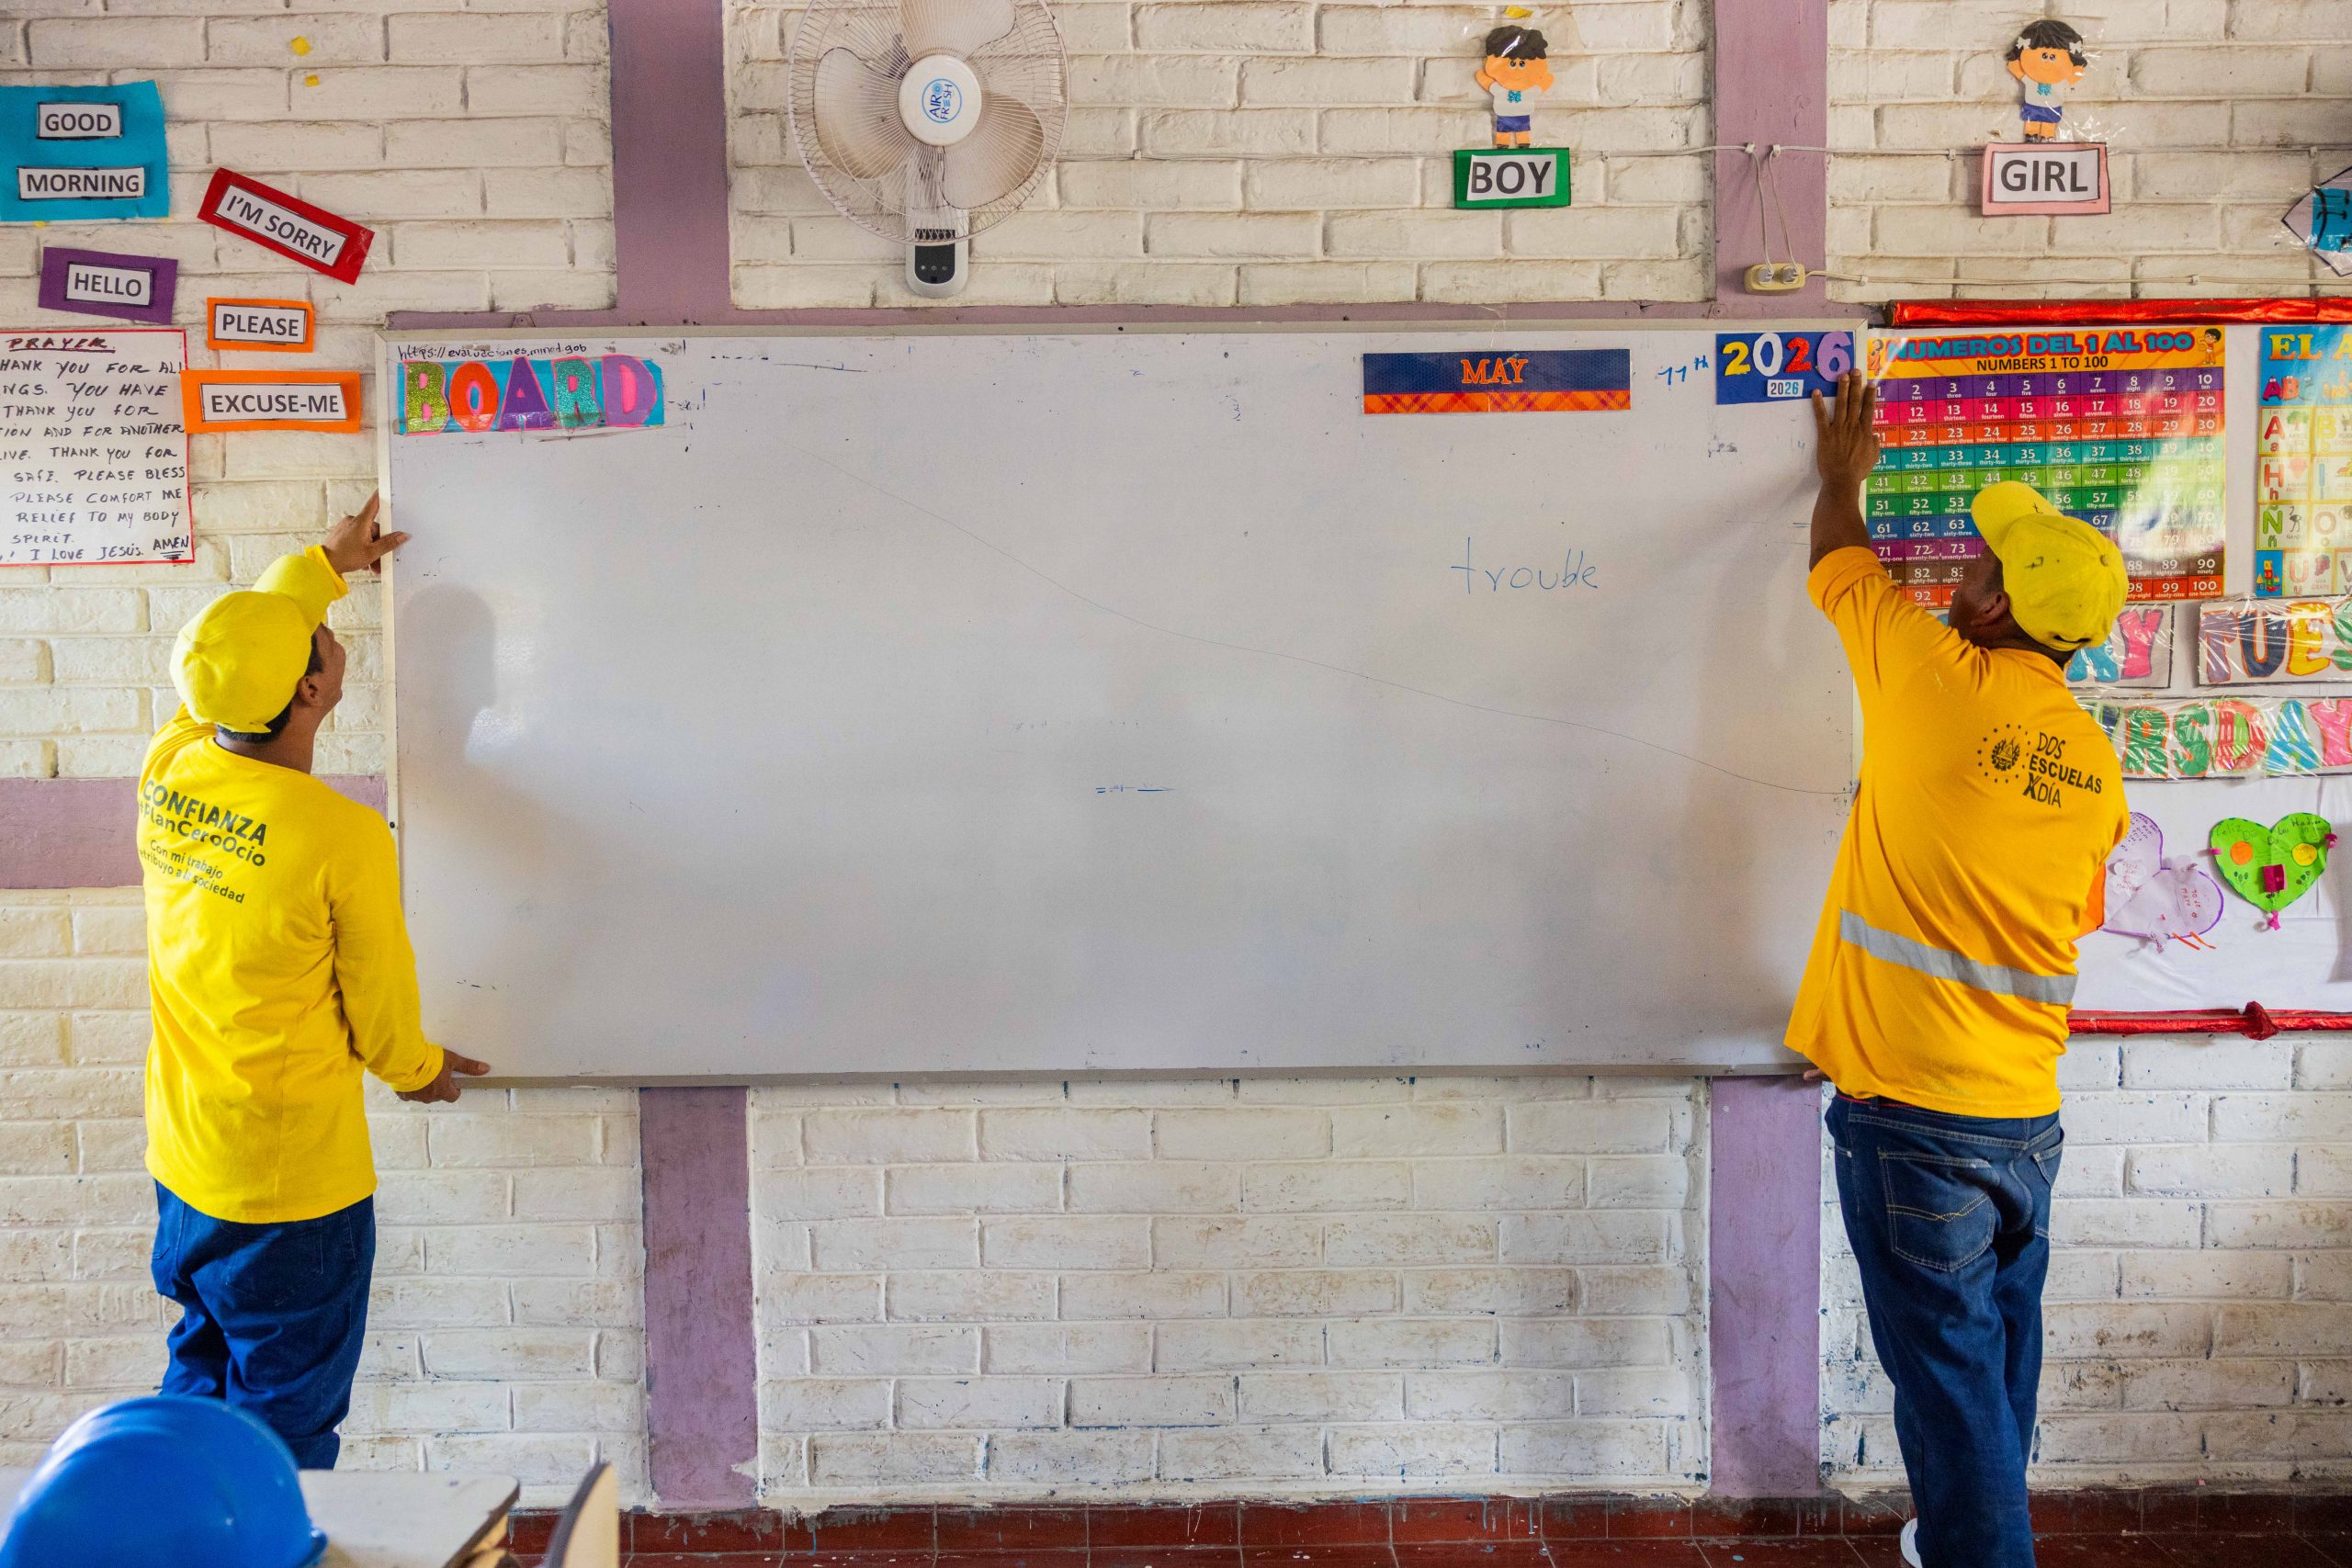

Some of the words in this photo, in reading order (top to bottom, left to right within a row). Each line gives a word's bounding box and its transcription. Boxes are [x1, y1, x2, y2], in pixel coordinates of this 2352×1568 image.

[929, 95, 943, 118] AIR
[940, 84, 954, 120] FRESH
[45, 113, 112, 131] GOOD
[1470, 161, 1553, 195] BOY
[2000, 159, 2088, 193] GIRL
[26, 174, 140, 192] MORNING
[227, 195, 263, 226] I'M
[265, 214, 335, 259] SORRY
[74, 272, 141, 298] HELLO
[222, 313, 300, 337] PLEASE
[1887, 336, 2022, 360] NUMEROS
[2028, 334, 2083, 355] DEL
[2086, 334, 2099, 354] 1
[2102, 333, 2142, 353] AL
[2145, 333, 2194, 352] 100
[2268, 333, 2323, 360] EL
[1722, 330, 1852, 382] 2026
[0, 358, 42, 372] HANK
[55, 362, 90, 378] YOU
[106, 362, 150, 373] FOR
[1976, 358, 2046, 371] NUMBERS
[2051, 358, 2057, 368] 1
[2062, 357, 2080, 368] TO
[2085, 356, 2109, 367] 100
[1460, 357, 1528, 384] MAY
[2058, 379, 2065, 389] 6
[2094, 378, 2101, 388] 7
[2131, 377, 2138, 386] 8
[2165, 376, 2174, 385] 9
[2199, 375, 2212, 384] 10
[1770, 382, 1799, 395] 2026
[1913, 385, 1920, 394] 2
[1950, 383, 1957, 393] 3
[1986, 381, 1995, 391] 4
[2023, 380, 2030, 390] 5
[0, 384, 47, 396] NGS.
[66, 382, 108, 401] YOU
[119, 383, 168, 396] HAVE
[403, 354, 658, 436] BOARD
[211, 395, 339, 412] EXCUSE-ME
[2093, 401, 2105, 411] 17
[2199, 397, 2215, 406] 20
[3, 405, 55, 416] THANK
[1910, 407, 1924, 417] 12
[1948, 405, 1961, 414] 13
[1984, 404, 1997, 413] 14
[2021, 402, 2033, 412] 15
[2056, 402, 2069, 412] 16
[2056, 424, 2072, 434] 26
[2091, 423, 2106, 433] 27
[2128, 423, 2143, 432] 28
[2199, 420, 2216, 429] 30
[2264, 415, 2286, 440] A
[0, 425, 32, 437] ION
[43, 426, 72, 437] AND
[83, 425, 112, 437] FOR
[120, 423, 185, 436] ANOTHER
[1948, 428, 1963, 437] 23
[1984, 427, 2000, 437] 24
[2021, 425, 2036, 435] 25
[1910, 431, 1927, 440] 22
[0, 449, 31, 460] IVE.
[50, 446, 99, 457] THANK
[107, 448, 130, 465] YOU
[1949, 451, 1963, 460] 33
[1984, 450, 1999, 459] 34
[2021, 449, 2036, 458] 35
[2056, 448, 2071, 457] 36
[2091, 446, 2106, 456] 37
[2128, 446, 2142, 455] 38
[1912, 452, 1927, 461] 32
[74, 469, 135, 481] PLEASE
[145, 466, 185, 479] BLESS
[2091, 468, 2106, 479] 47
[2125, 468, 2141, 478] 48
[2264, 464, 2284, 487] H
[1911, 475, 1928, 485] 42
[1949, 475, 1964, 484] 43
[9, 491, 74, 503] PLEASE
[162, 488, 182, 500] ME
[2093, 493, 2108, 502] 57
[2269, 488, 2278, 500] h
[1876, 501, 1889, 510] 51
[1949, 498, 1964, 507] 53
[88, 511, 107, 522] TO
[143, 511, 179, 527] BODY
[2093, 515, 2108, 525] 67
[2263, 505, 2283, 534] Ñ
[1913, 522, 1929, 532] 62
[1950, 520, 1964, 529] 63
[30, 548, 41, 561] I
[51, 548, 85, 560] LOVE
[153, 536, 189, 550] AMEN
[1915, 546, 1929, 555] 72
[1951, 544, 1965, 553] 73
[1451, 537, 1599, 594] trouble
[2198, 559, 2215, 569] 90
[1915, 568, 1929, 578] 82
[2290, 558, 2309, 582] U
[2163, 583, 2178, 592] 99
[2193, 581, 2217, 591] 100
[1915, 592, 1930, 601] 92
[2084, 697, 2352, 778] RSDAY
[2037, 732, 2065, 760] DOS
[2029, 753, 2102, 794] ESCUELAS
[143, 780, 267, 846] CONFIANZA
[150, 840, 168, 858] Con
[171, 852, 187, 864] mi
[187, 855, 223, 880] trabajo
[140, 850, 174, 874] tribuyo
[176, 869, 182, 877] a
[193, 874, 245, 904] sociedad
